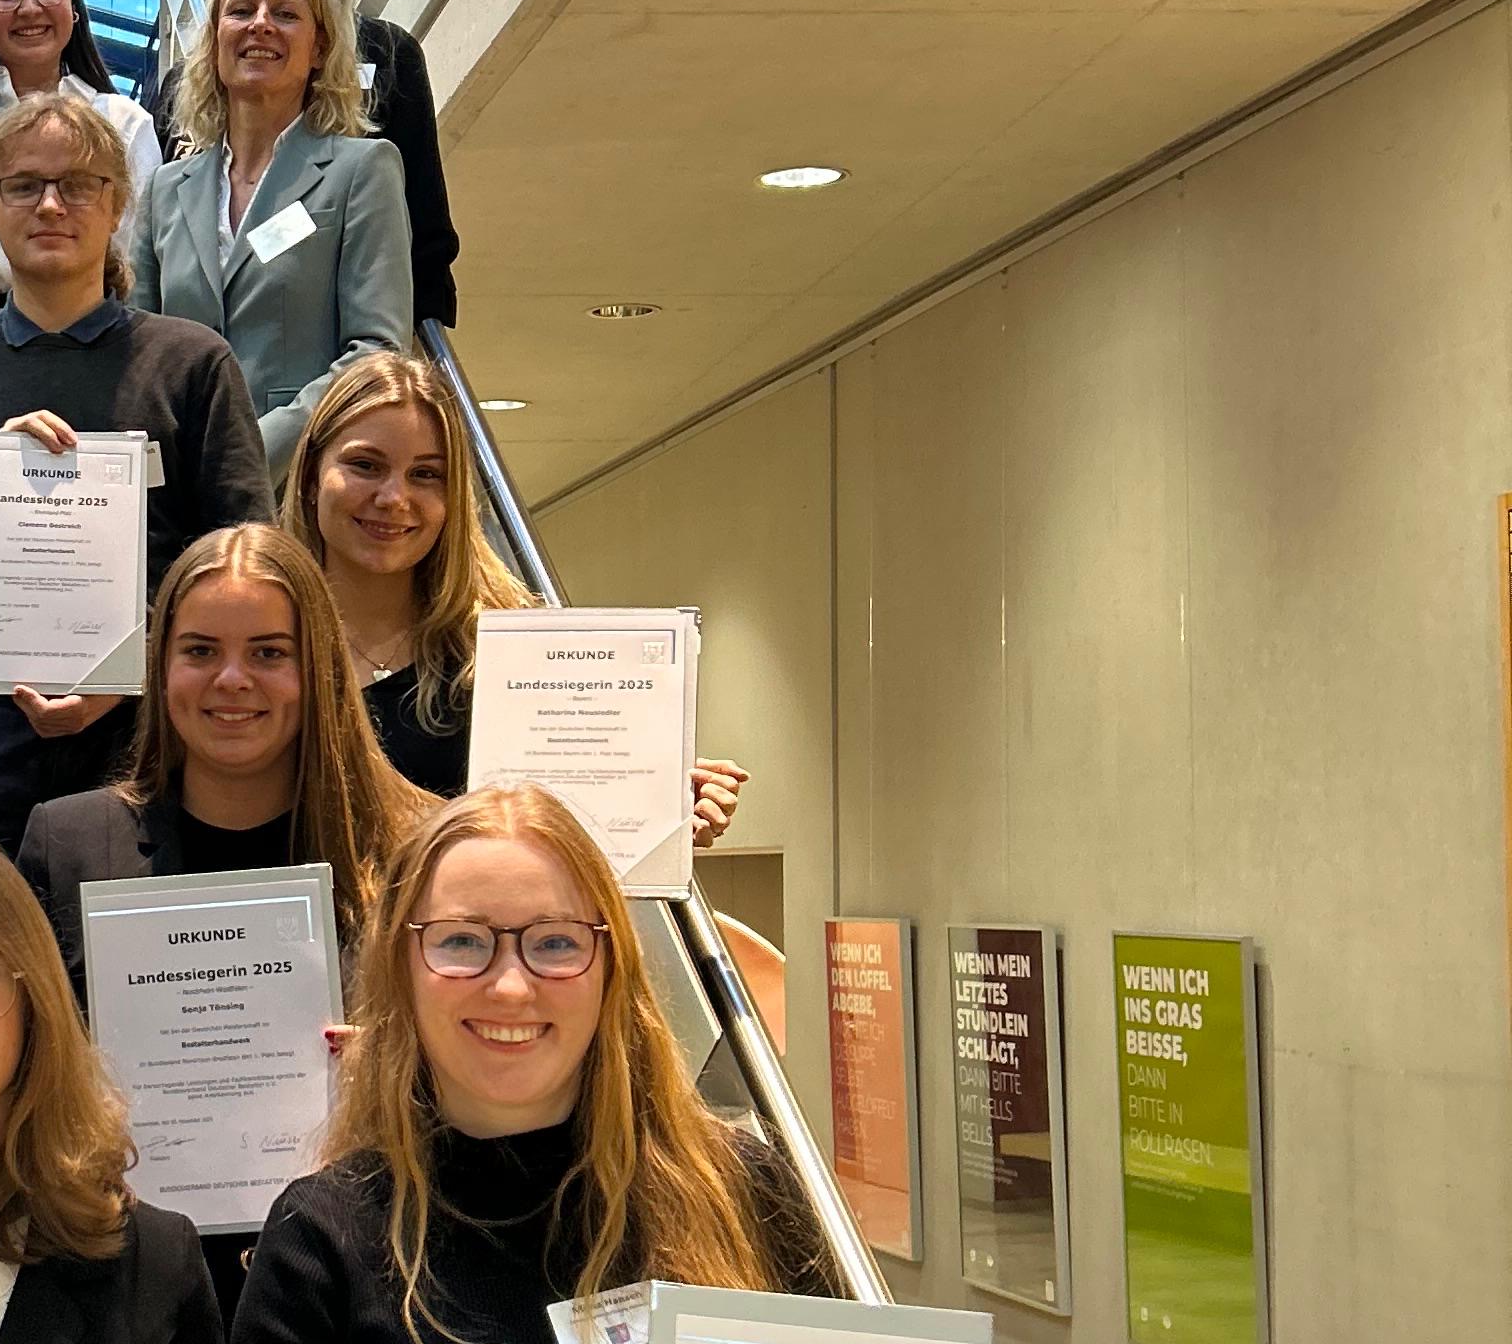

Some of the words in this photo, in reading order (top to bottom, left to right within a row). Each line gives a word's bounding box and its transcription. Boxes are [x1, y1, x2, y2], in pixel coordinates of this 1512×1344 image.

[22, 468, 81, 479] URKUNDE
[77, 497, 107, 506] 2025
[547, 650, 615, 660] URKUNDE
[507, 679, 612, 691] Landessiegerin
[618, 679, 653, 689] 2025
[167, 927, 245, 944] URKUNDE
[830, 942, 861, 962] WENN
[863, 944, 881, 964] ICH
[954, 952, 995, 975] WENN
[998, 954, 1031, 978] MEIN
[127, 964, 247, 985] Landessiegerin
[253, 960, 292, 975] 2025
[831, 967, 852, 988] DEN
[853, 964, 891, 990] LÖFFEL
[1122, 964, 1175, 993] WENN
[1179, 968, 1209, 996] ICH
[955, 980, 1008, 1005] LETZTES
[956, 1005, 1028, 1037] STÜNDLEIN
[1124, 997, 1152, 1024] INS
[1155, 1000, 1203, 1030] GRAS
[957, 1035, 1019, 1069] SCHLÄGT,
[1125, 1029, 1188, 1067] BEISSE,
[959, 1066, 990, 1089] DANN
[992, 1071, 1022, 1095] BITTE
[1127, 1063, 1167, 1090] DANN
[960, 1093, 977, 1113] MIT
[981, 1097, 1013, 1122] HELLS
[1128, 1095, 1166, 1123] BITTE
[1169, 1103, 1183, 1126] IN
[1129, 1128, 1215, 1168] ROLLRASEN.
